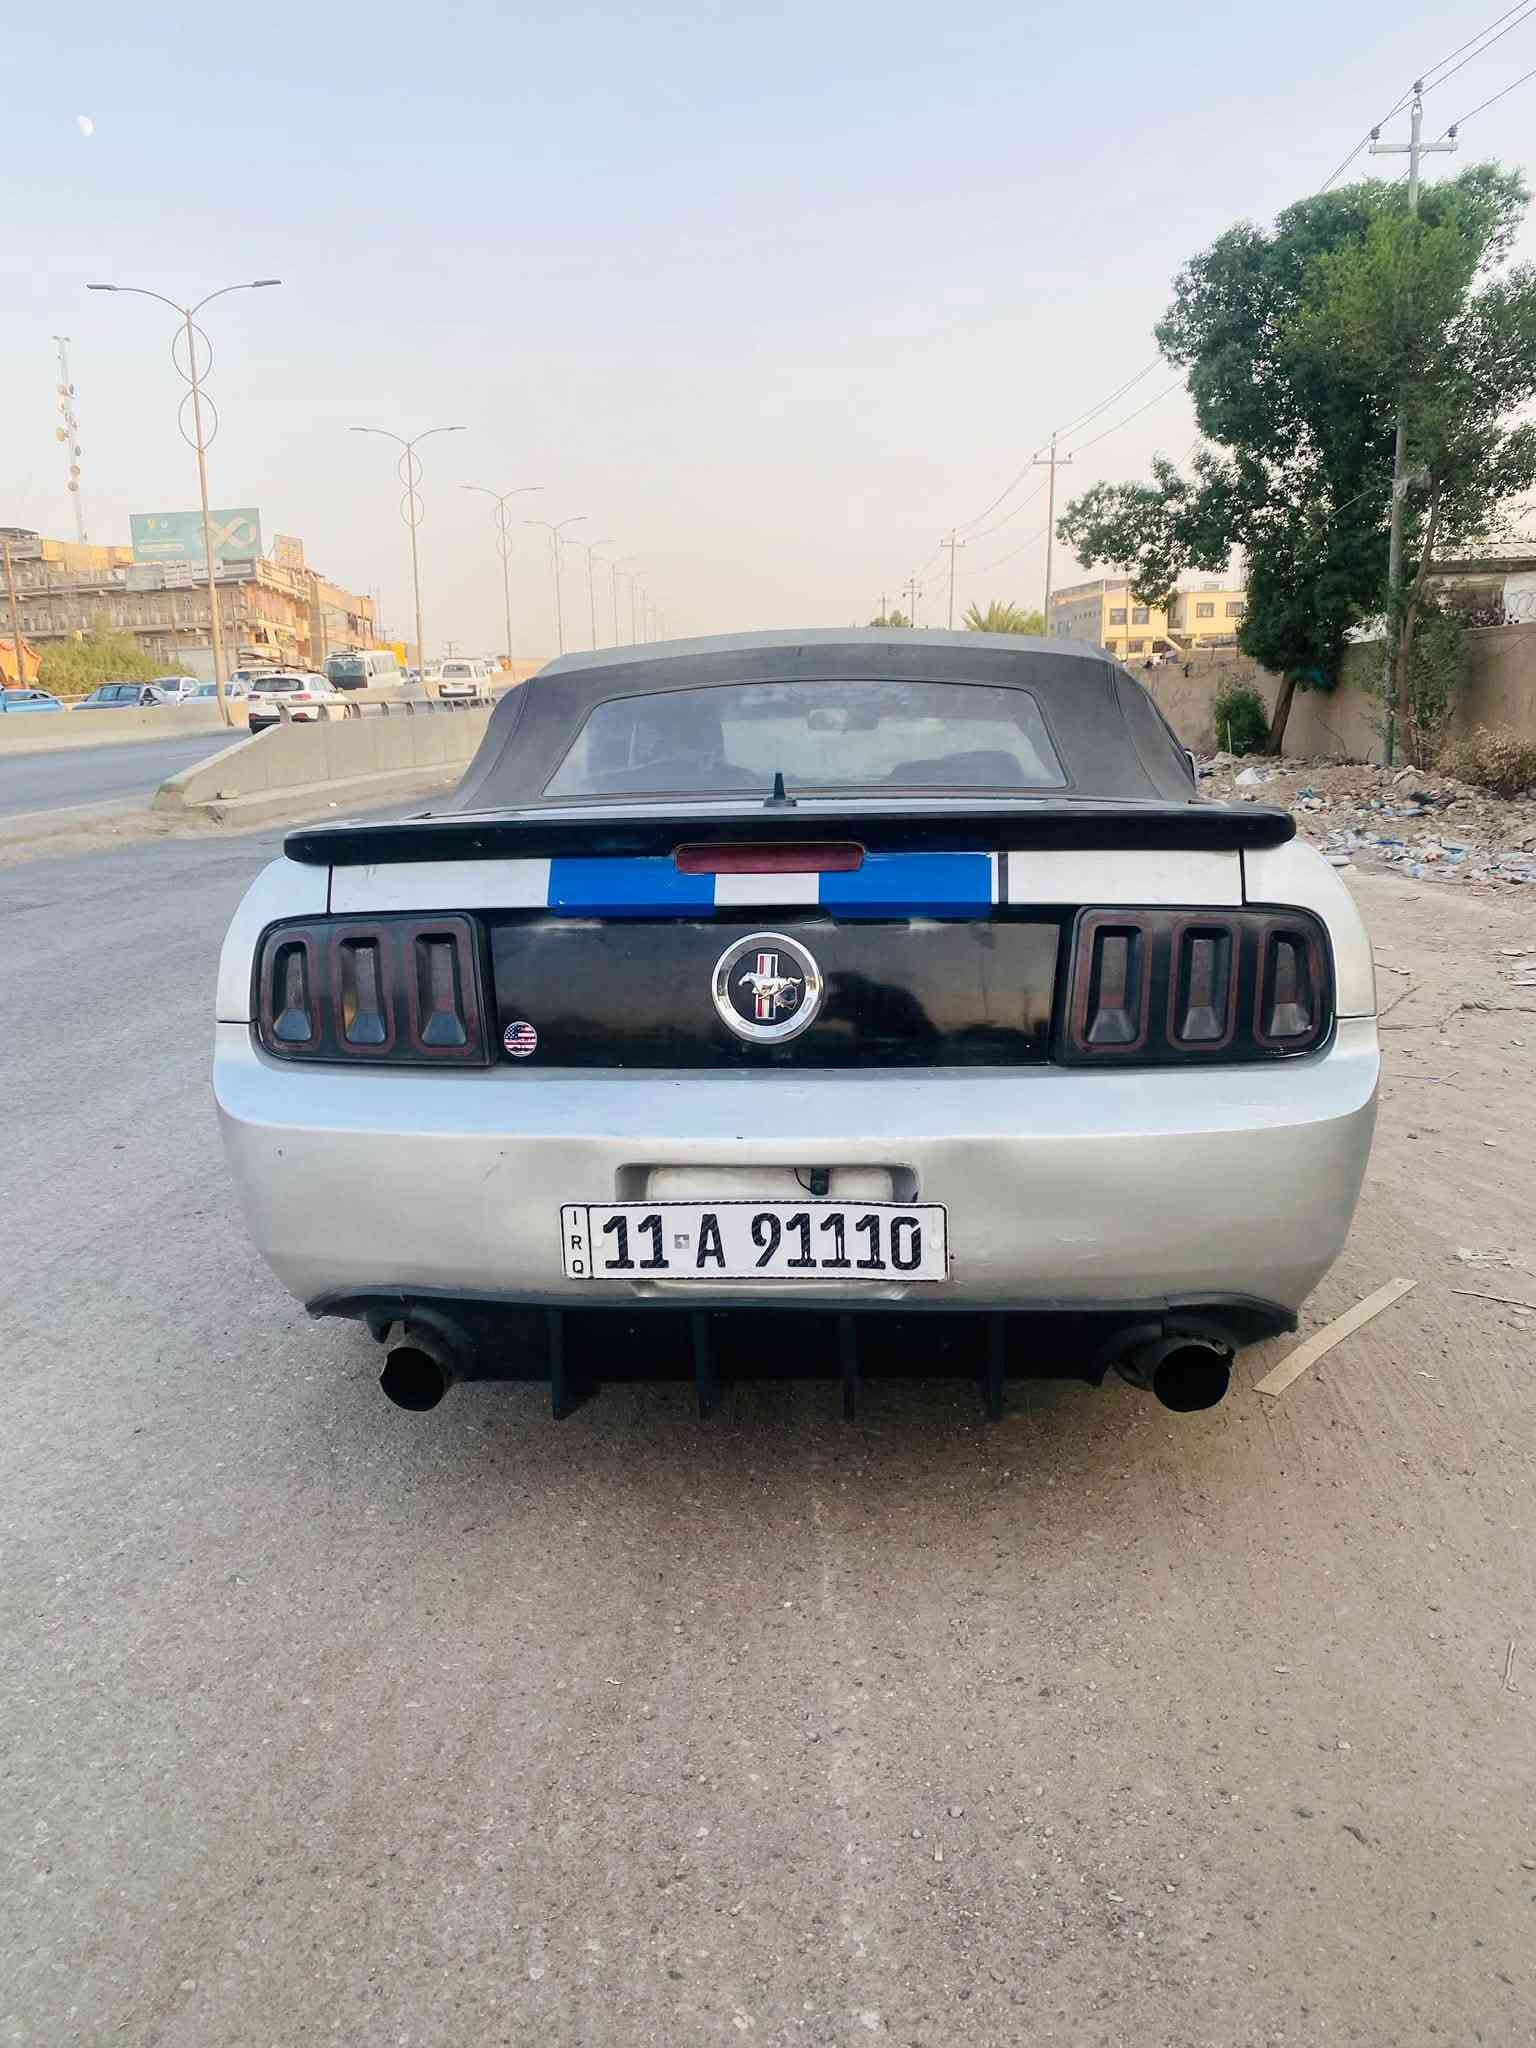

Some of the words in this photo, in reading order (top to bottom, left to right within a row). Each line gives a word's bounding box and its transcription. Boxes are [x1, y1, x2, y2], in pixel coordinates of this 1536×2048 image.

[571, 1210, 584, 1274] IRQ
[602, 1214, 670, 1269] 11
[696, 1213, 726, 1268] A
[751, 1212, 922, 1271] 91110
